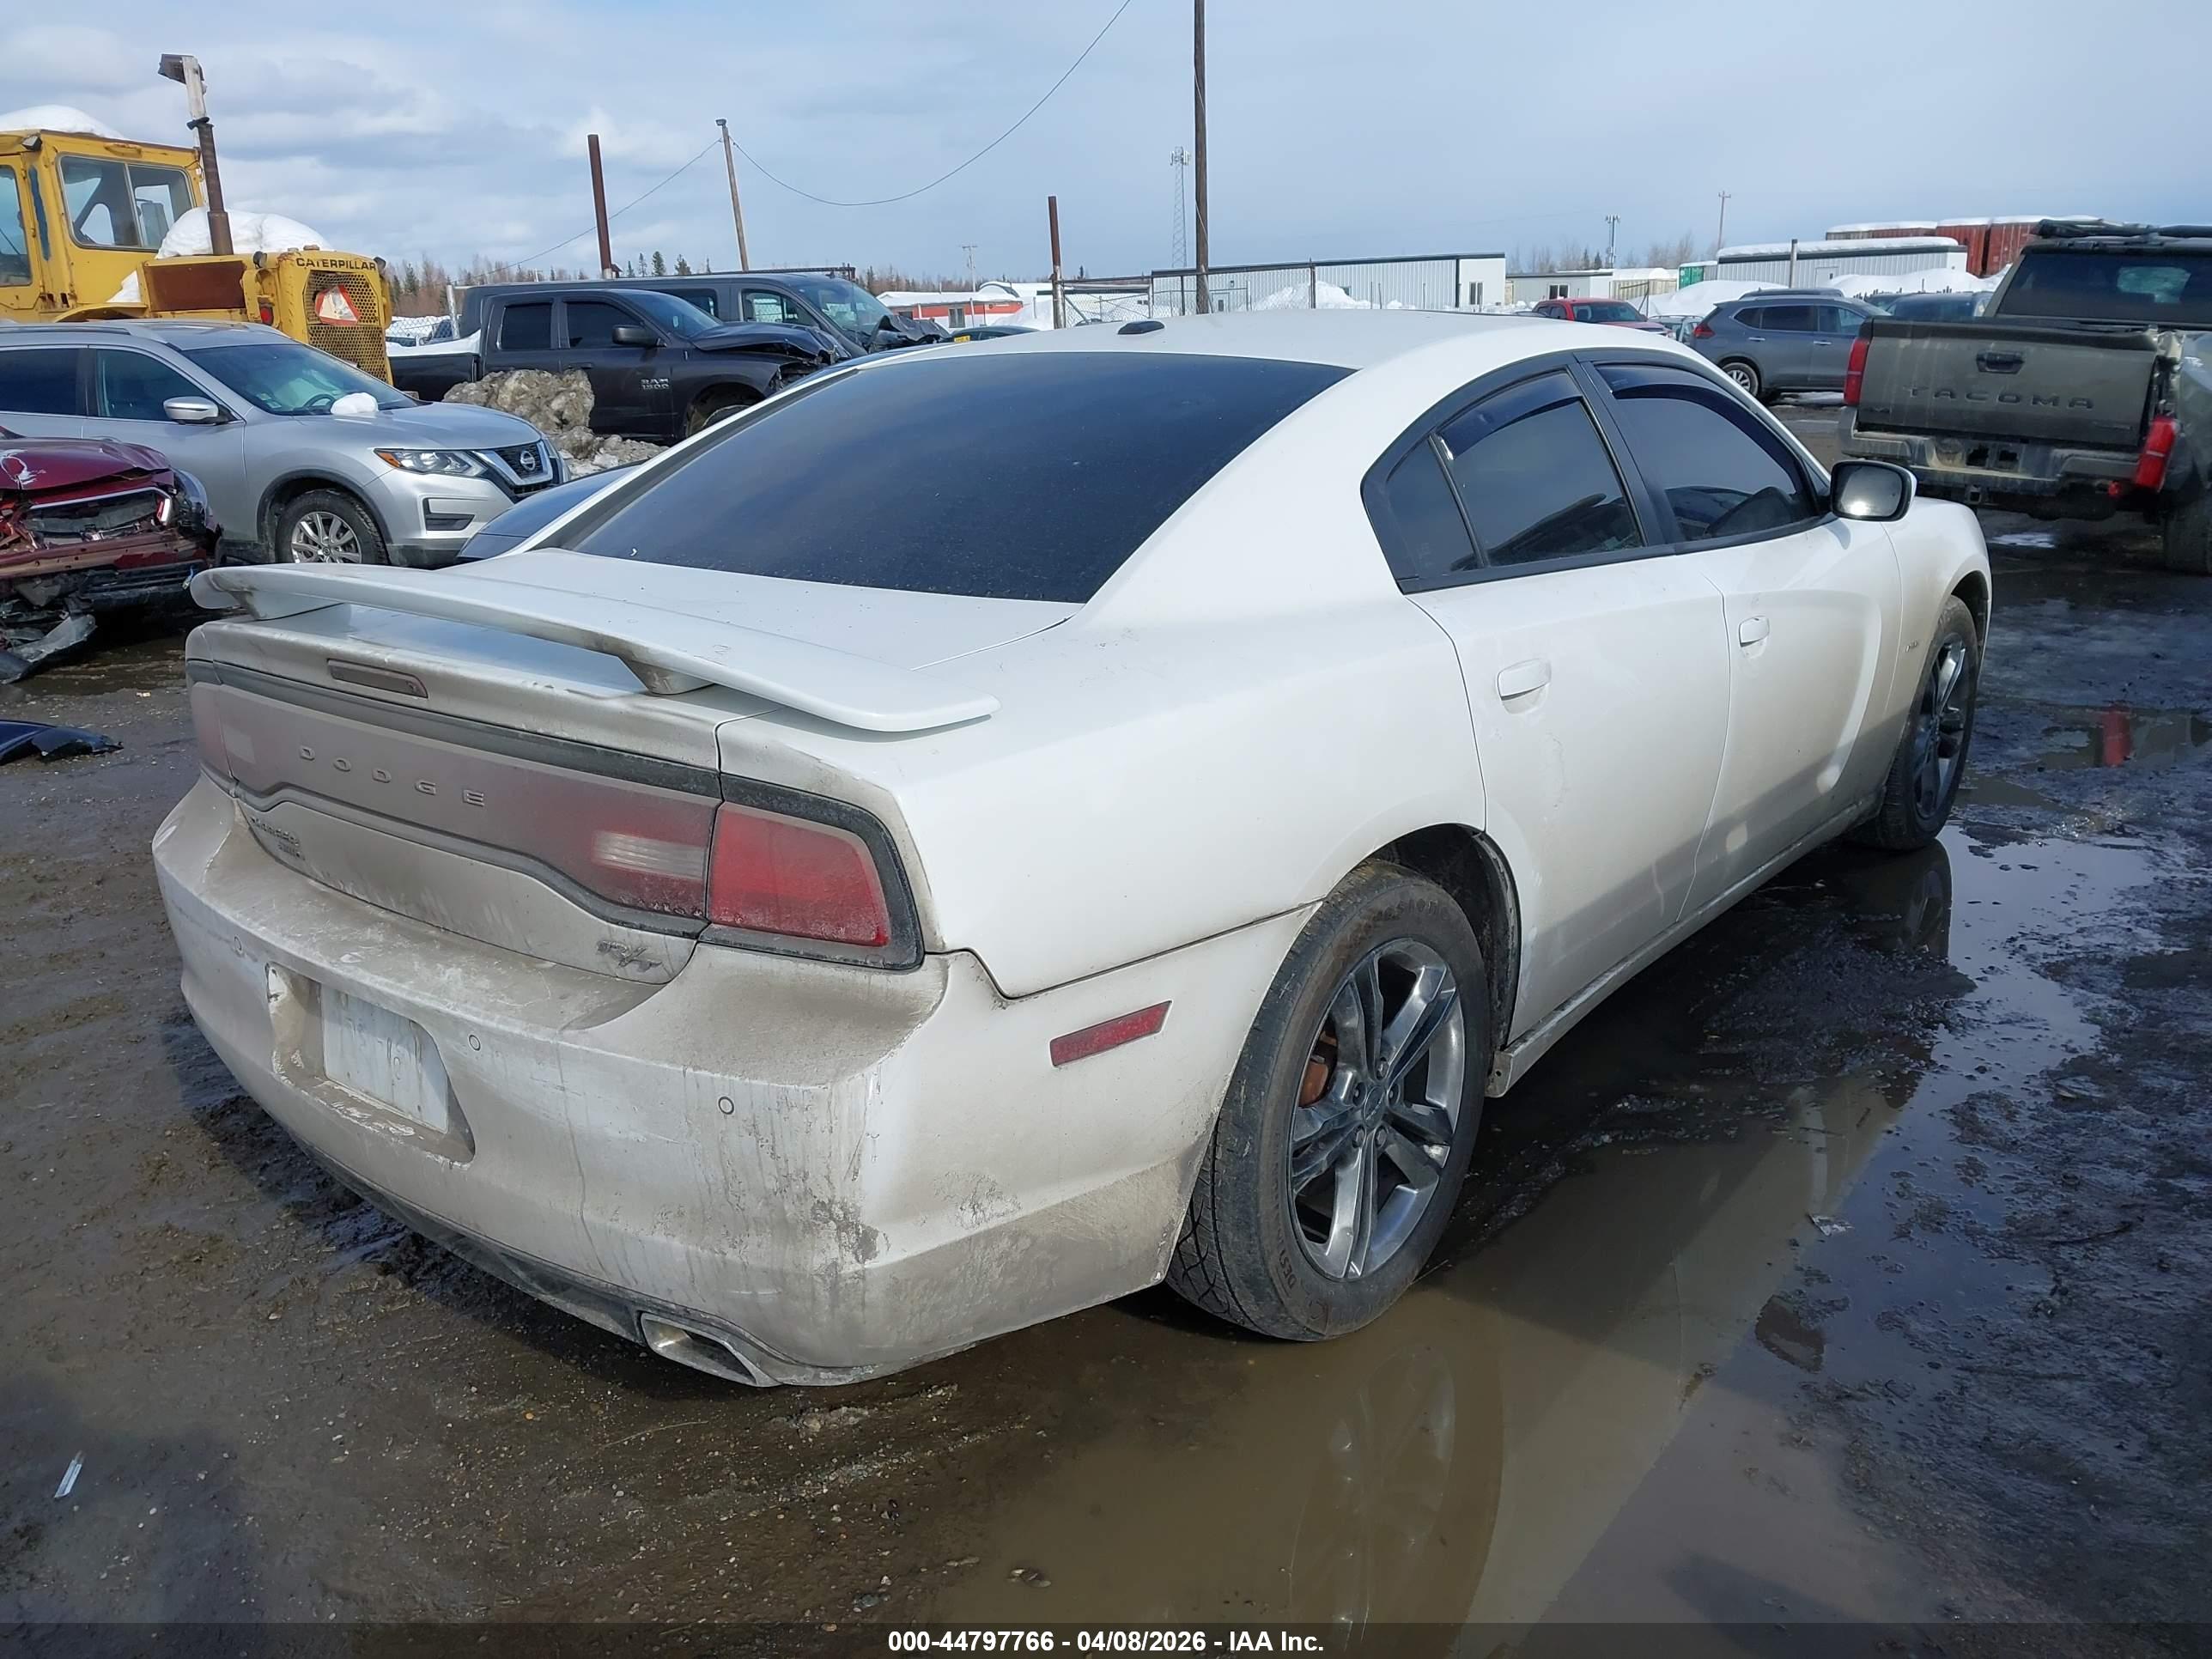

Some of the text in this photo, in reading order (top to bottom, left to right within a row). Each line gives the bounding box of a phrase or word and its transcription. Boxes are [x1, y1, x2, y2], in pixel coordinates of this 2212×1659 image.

[295, 258, 376, 270] CATERPILLAR
[1902, 386, 2094, 410] TACOMA
[300, 745, 484, 806] DODGE
